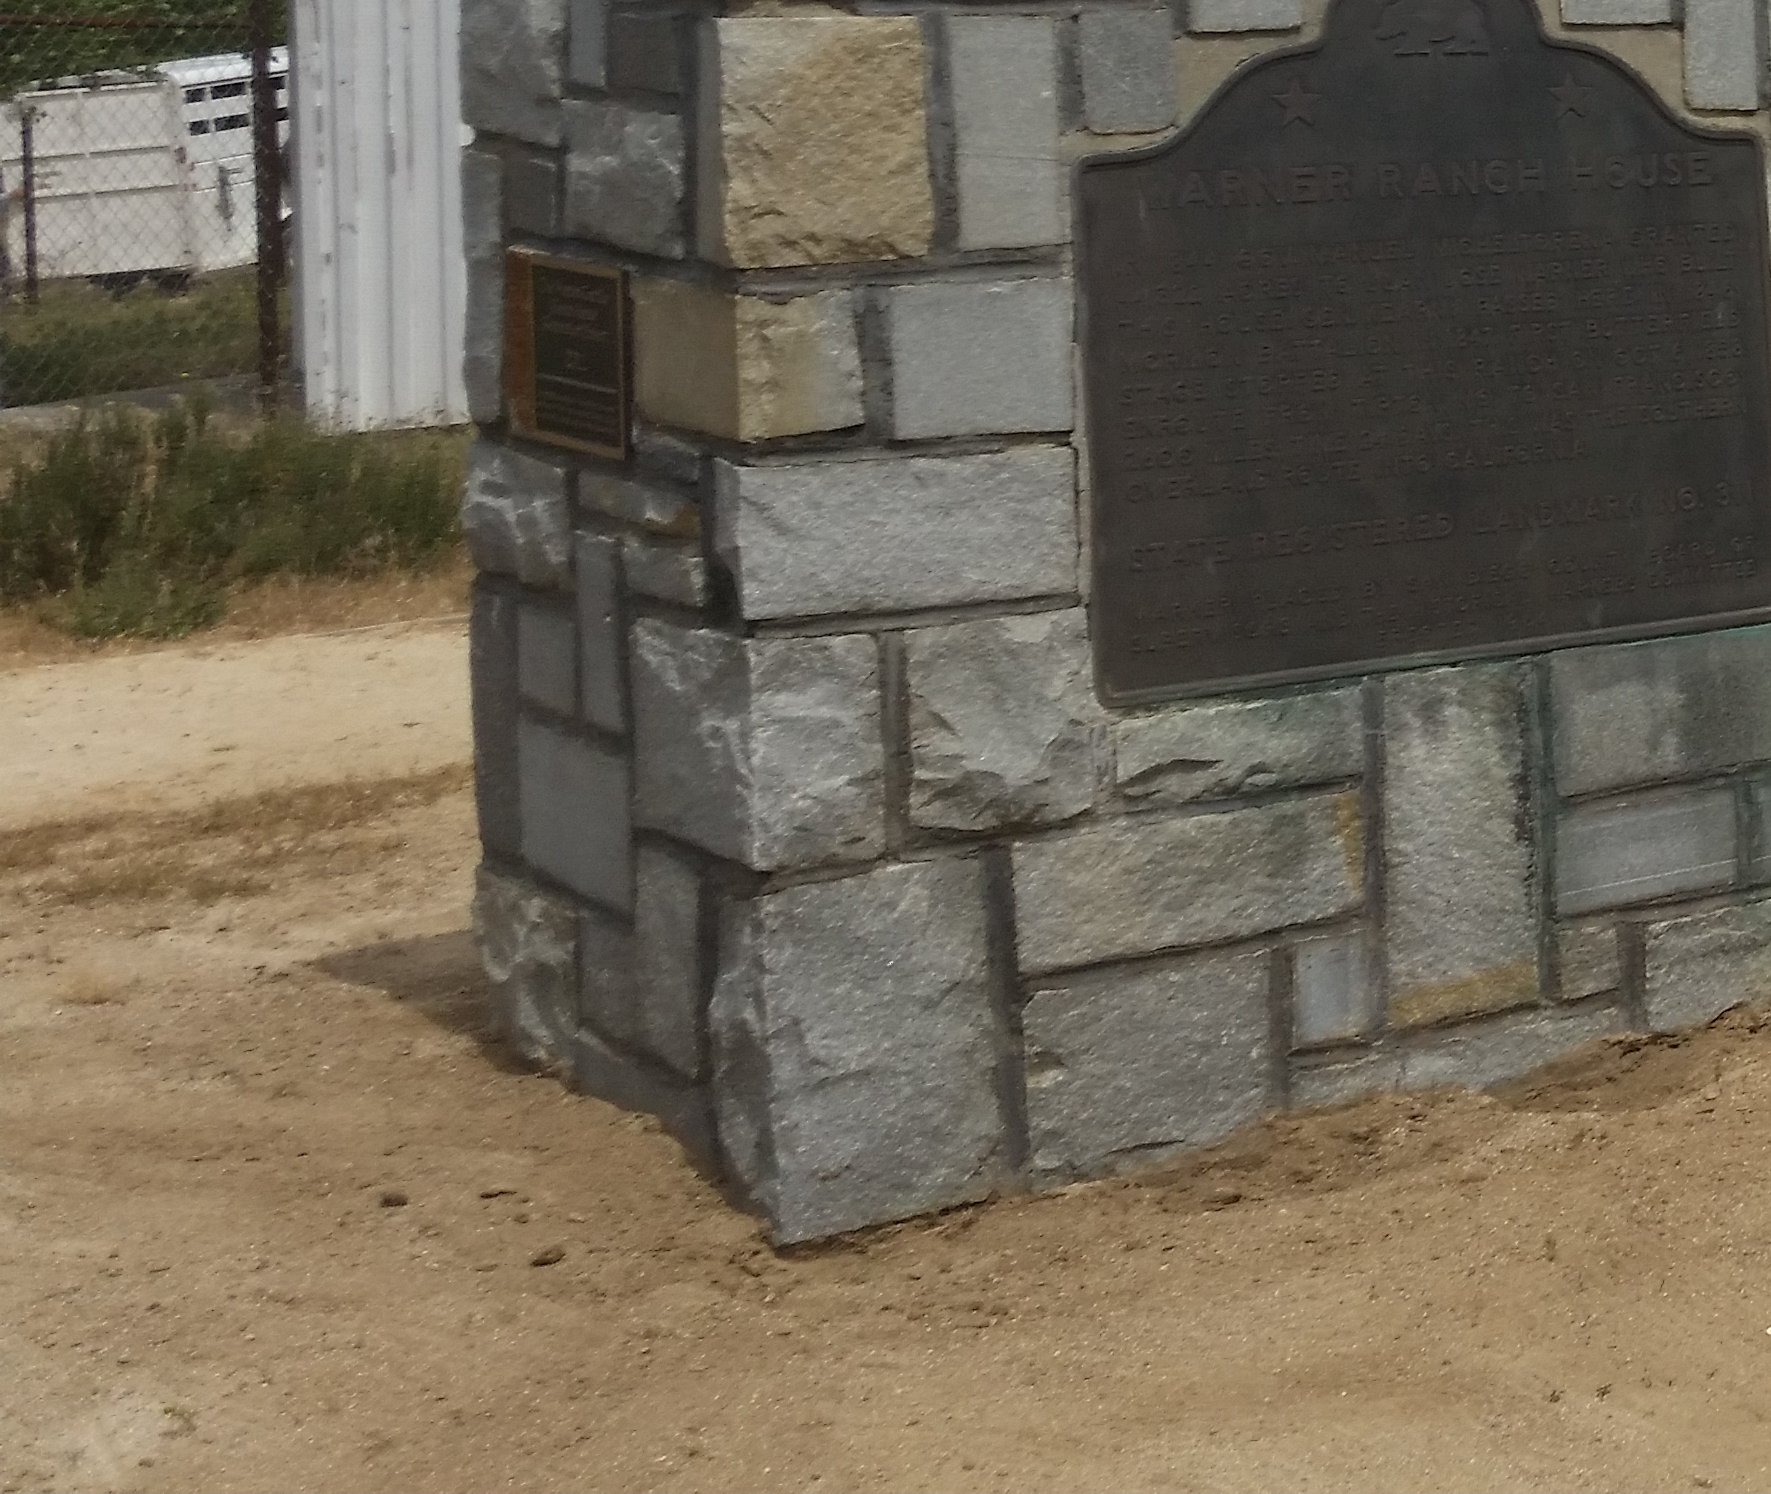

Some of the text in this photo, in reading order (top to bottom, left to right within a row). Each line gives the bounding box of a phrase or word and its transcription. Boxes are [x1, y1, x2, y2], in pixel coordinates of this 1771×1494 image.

[1136, 149, 1714, 210] WARNER RANCH HOUSE
[1127, 532, 1232, 573] STATE
[1250, 508, 1456, 559] REGISTERED
